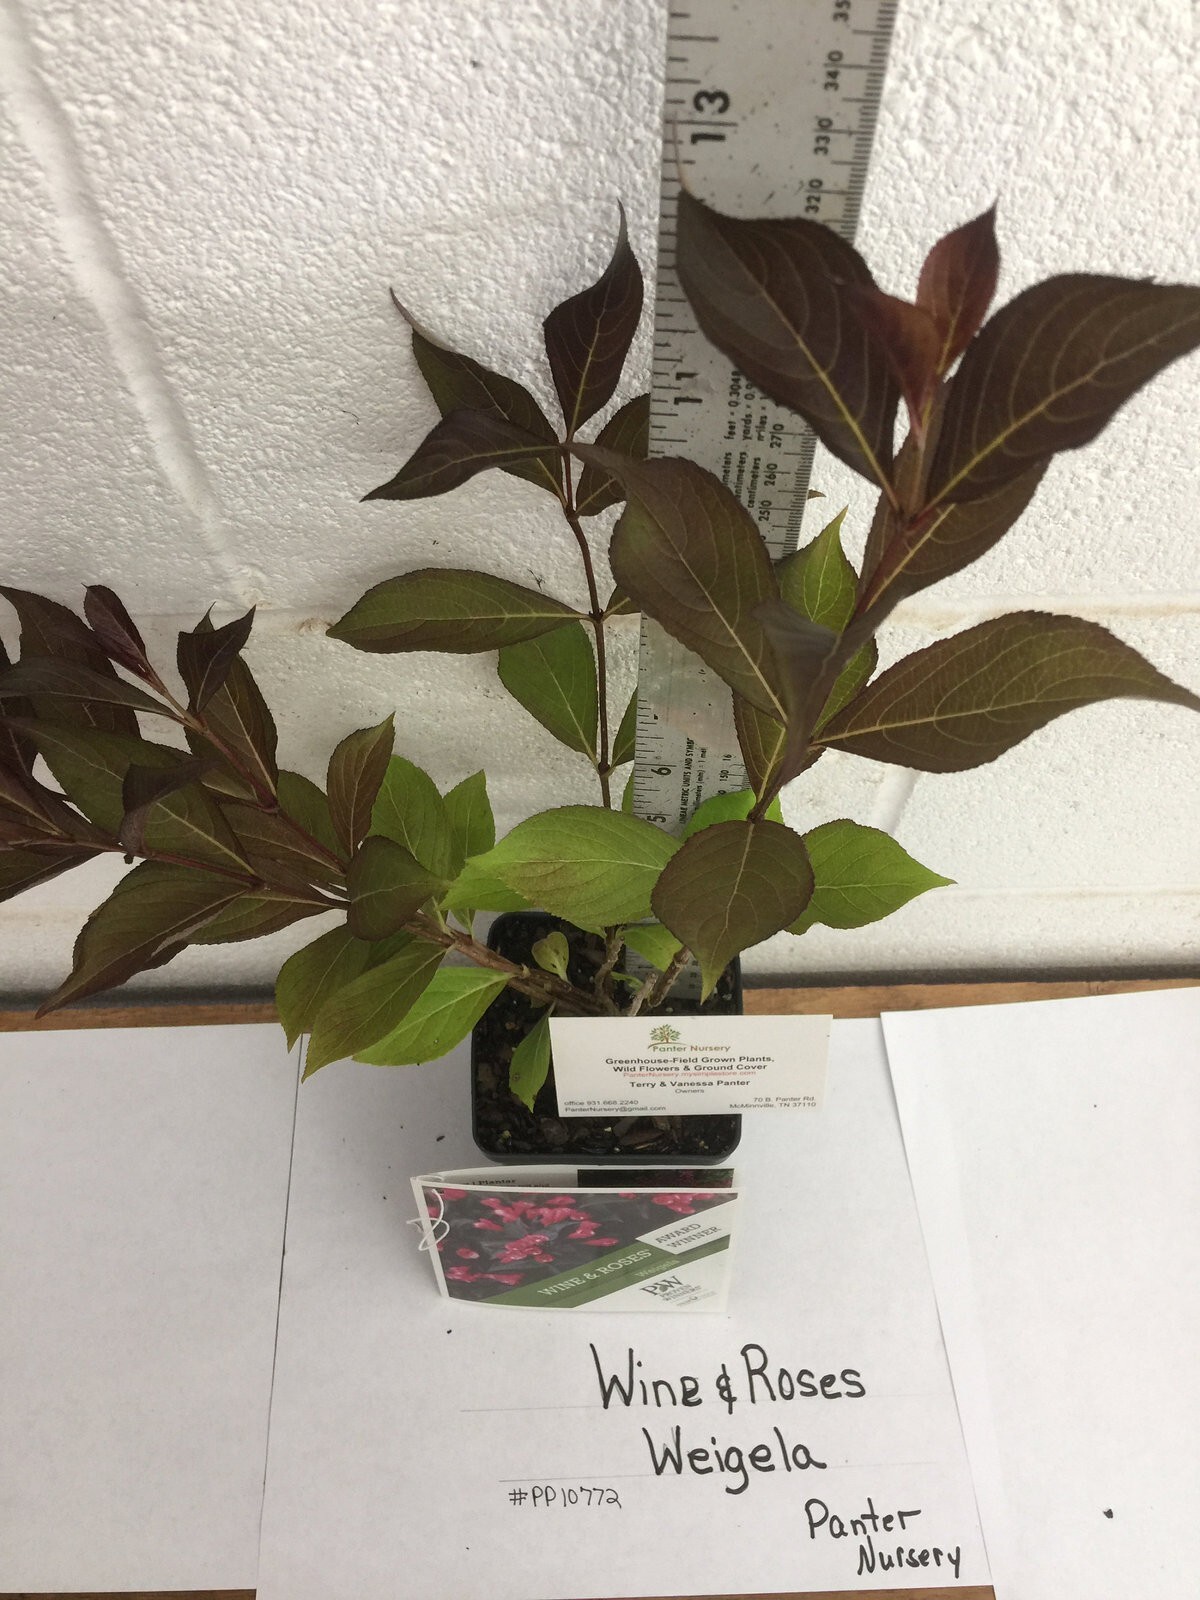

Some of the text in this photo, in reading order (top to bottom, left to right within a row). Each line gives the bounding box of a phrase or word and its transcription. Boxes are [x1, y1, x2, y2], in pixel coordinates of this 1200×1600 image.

[823, 50, 843, 91] 340
[690, 90, 731, 145] 13
[813, 117, 833, 155] 330
[804, 178, 823, 214] 320
[769, 423, 785, 449] 270
[764, 463, 778, 487] 260
[758, 500, 773, 521] 250
[605, 1057, 698, 1065] Greenhouse-Field
[655, 1223, 701, 1244] AWARD
[667, 1226, 722, 1248] WINNER
[537, 1249, 652, 1296] WINE & ROSES
[590, 1343, 866, 1414] Wine & Roses
[642, 1425, 827, 1494] Weigela
[508, 1486, 622, 1508] #PP10772
[805, 1497, 922, 1539] Panter
[857, 1536, 961, 1578] Nursery
